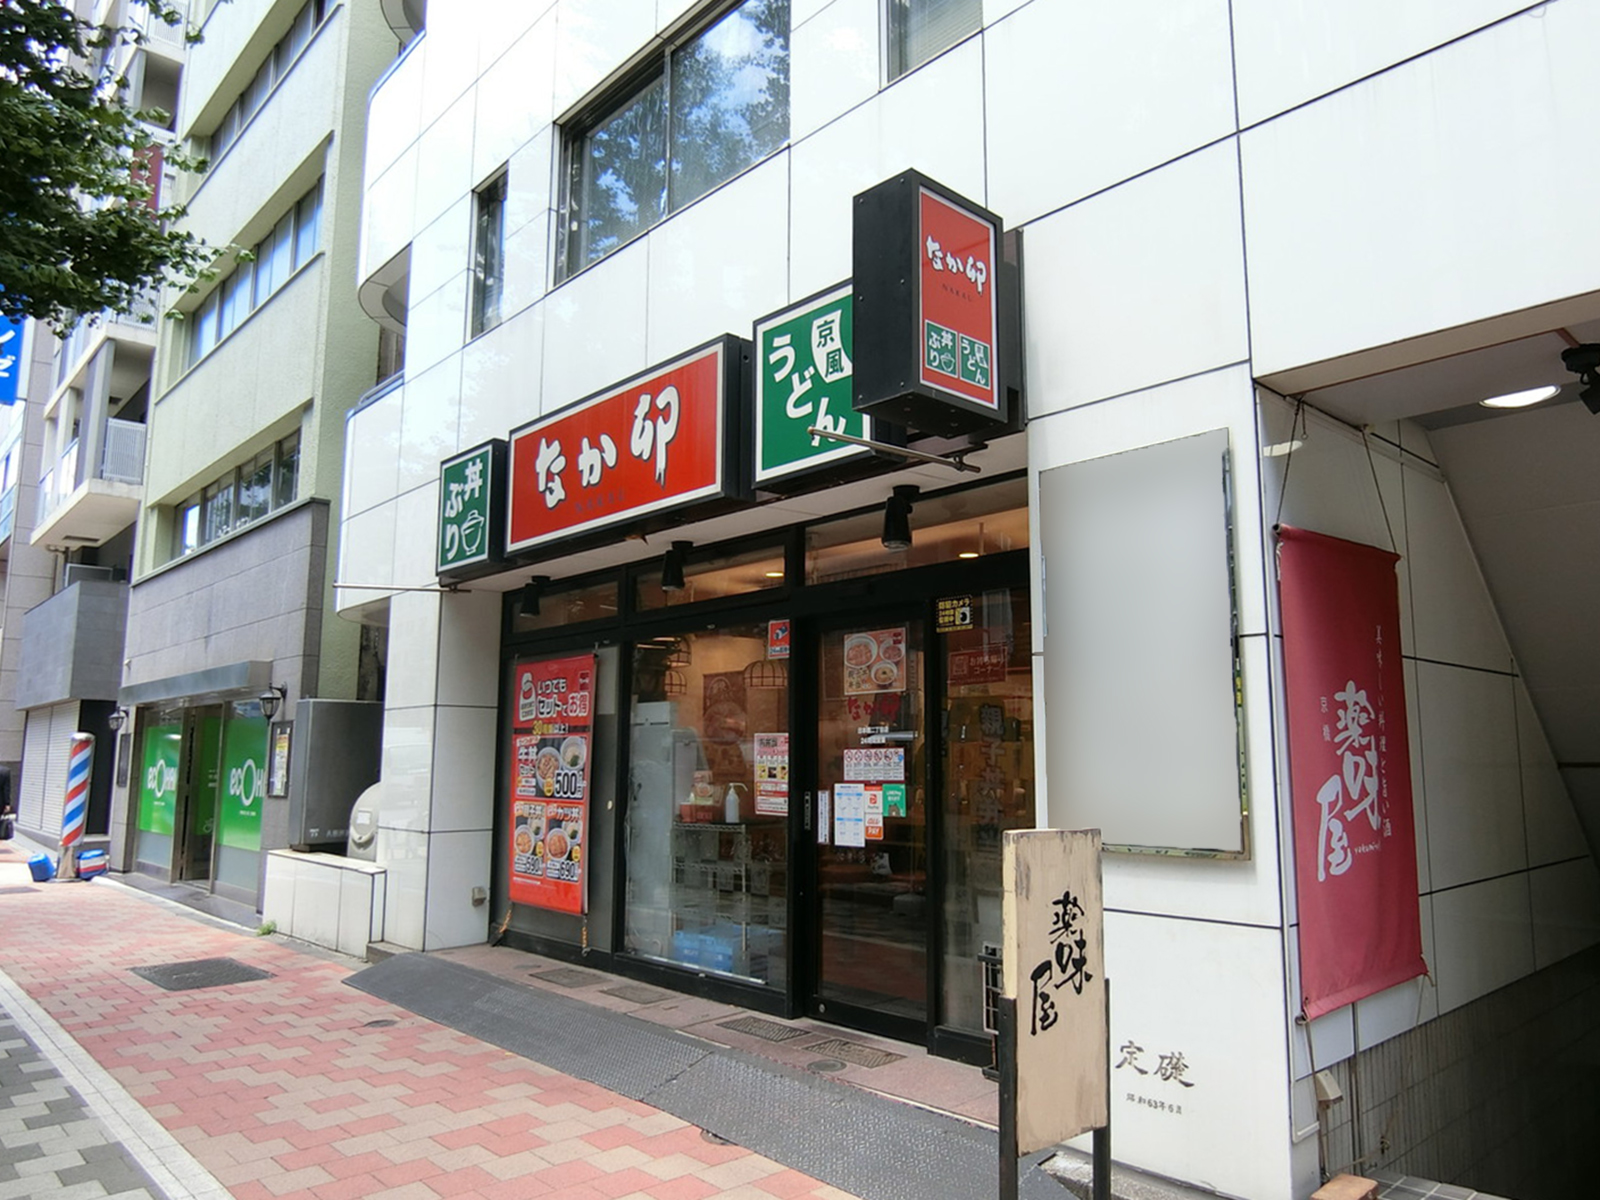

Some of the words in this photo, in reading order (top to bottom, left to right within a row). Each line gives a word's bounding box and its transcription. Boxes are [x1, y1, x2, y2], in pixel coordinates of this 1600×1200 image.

[926, 234, 988, 296] なか卯
[815, 318, 847, 379] 京風
[961, 338, 986, 385] うどん
[767, 333, 848, 448] うどん
[535, 383, 681, 511] なか卯
[537, 678, 567, 694] いつでも
[1030, 890, 1093, 1036] 薬味屋
[1114, 1039, 1195, 1088] 定礎
